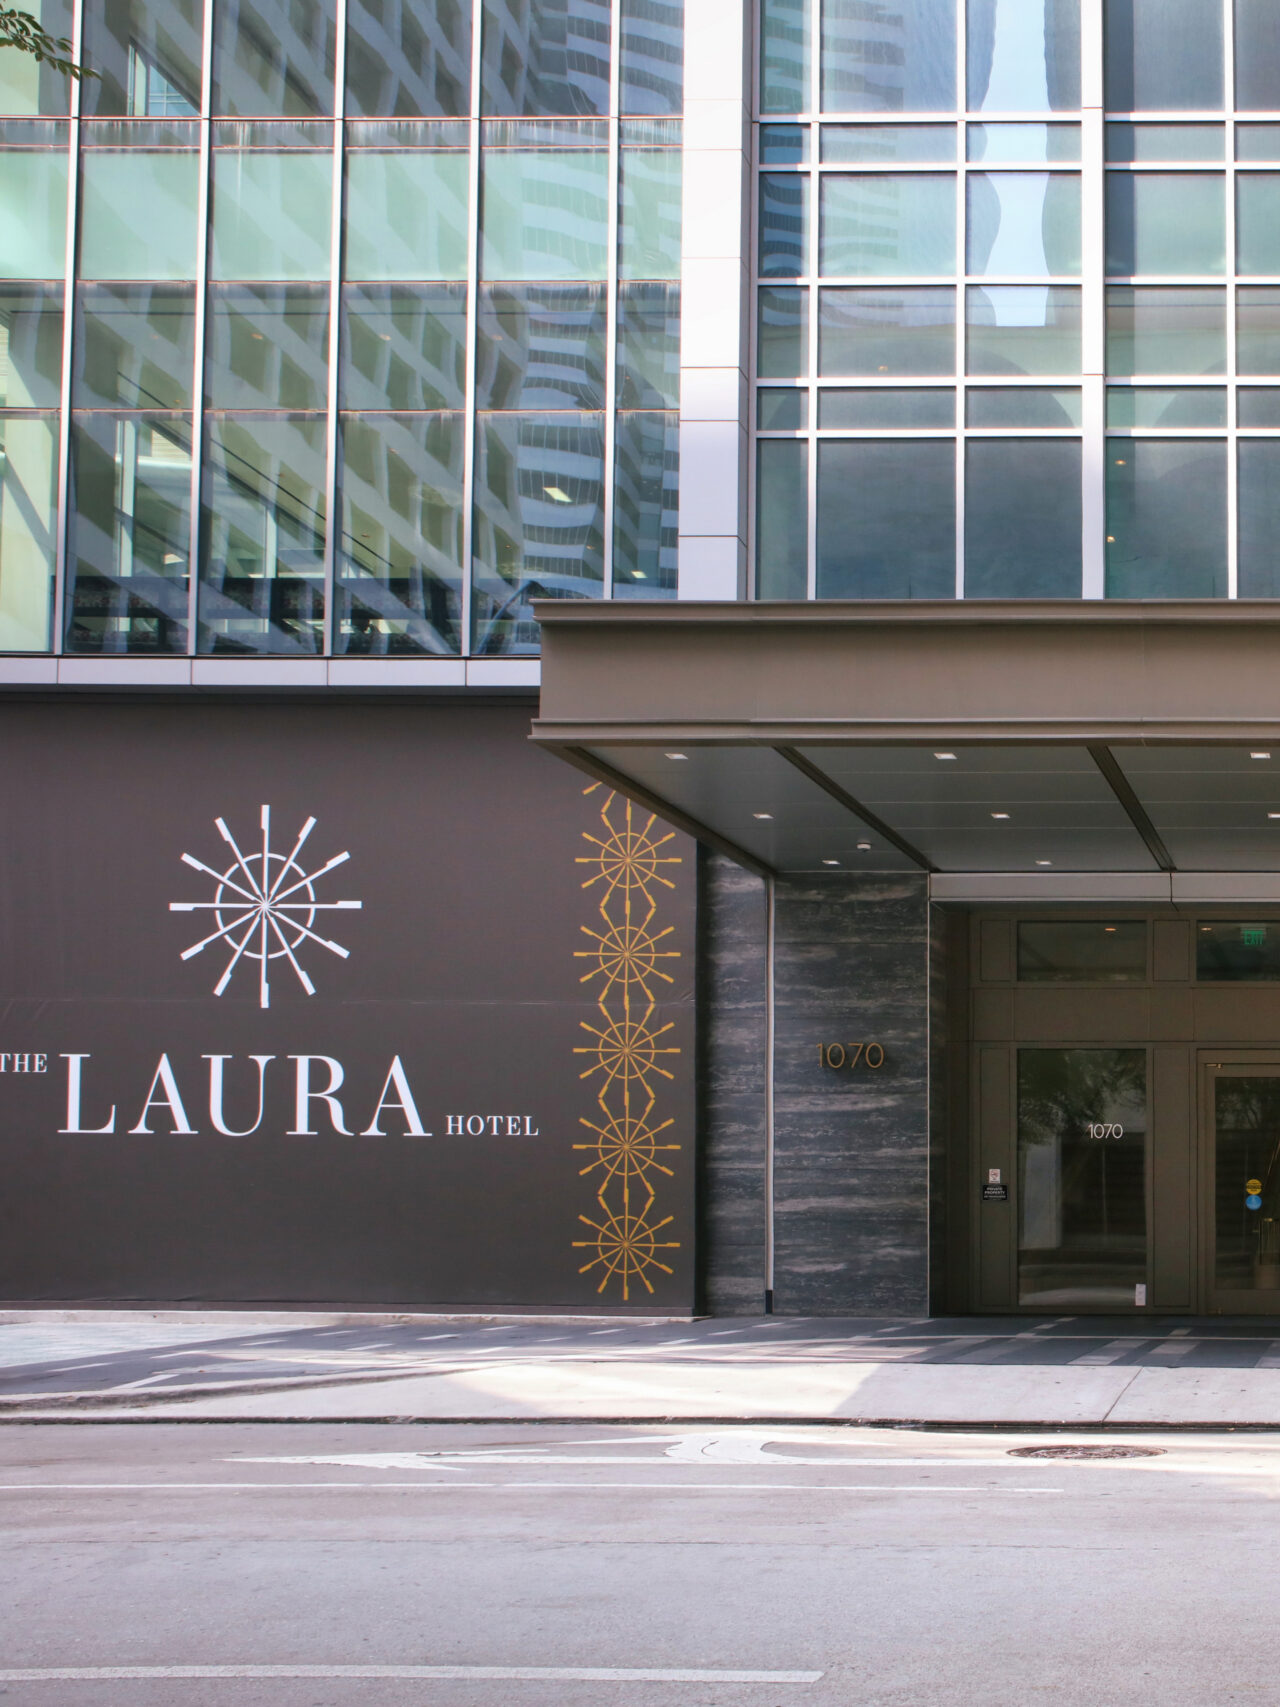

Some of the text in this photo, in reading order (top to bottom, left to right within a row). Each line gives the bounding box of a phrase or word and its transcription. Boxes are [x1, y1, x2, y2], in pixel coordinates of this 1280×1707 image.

[1243, 930, 1263, 945] EXIT
[816, 1042, 884, 1069] 1070
[0, 1053, 539, 1137] THE LAURA HOTEL
[1088, 1123, 1123, 1139] 1070
